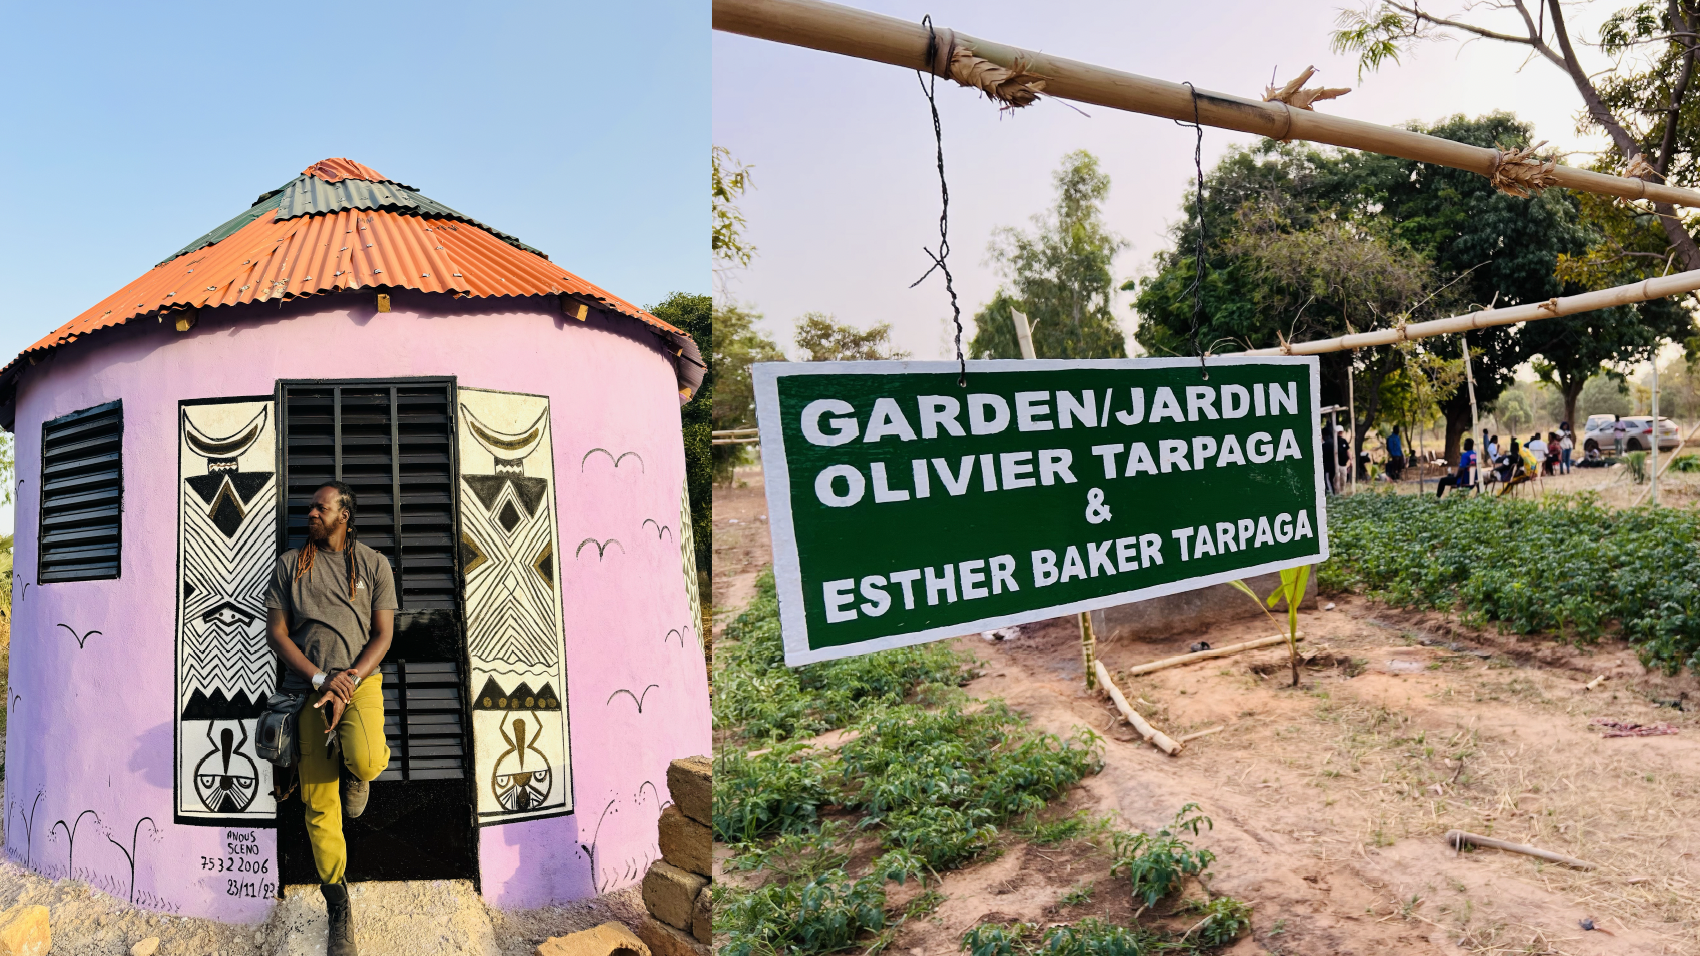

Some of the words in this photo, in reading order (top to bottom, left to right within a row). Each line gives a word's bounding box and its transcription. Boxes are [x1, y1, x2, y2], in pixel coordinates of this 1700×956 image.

[800, 381, 1299, 447] GARDEN/JARDIN
[814, 448, 1078, 508] OLIVIER
[1091, 428, 1303, 480] TARPAGA
[1085, 487, 1113, 524] &
[822, 554, 1020, 624] ESTHER
[1031, 532, 1164, 588] BAKER
[1171, 509, 1314, 562] TARPAGA
[227, 830, 256, 843] ANOUS
[227, 842, 260, 855] SCENO
